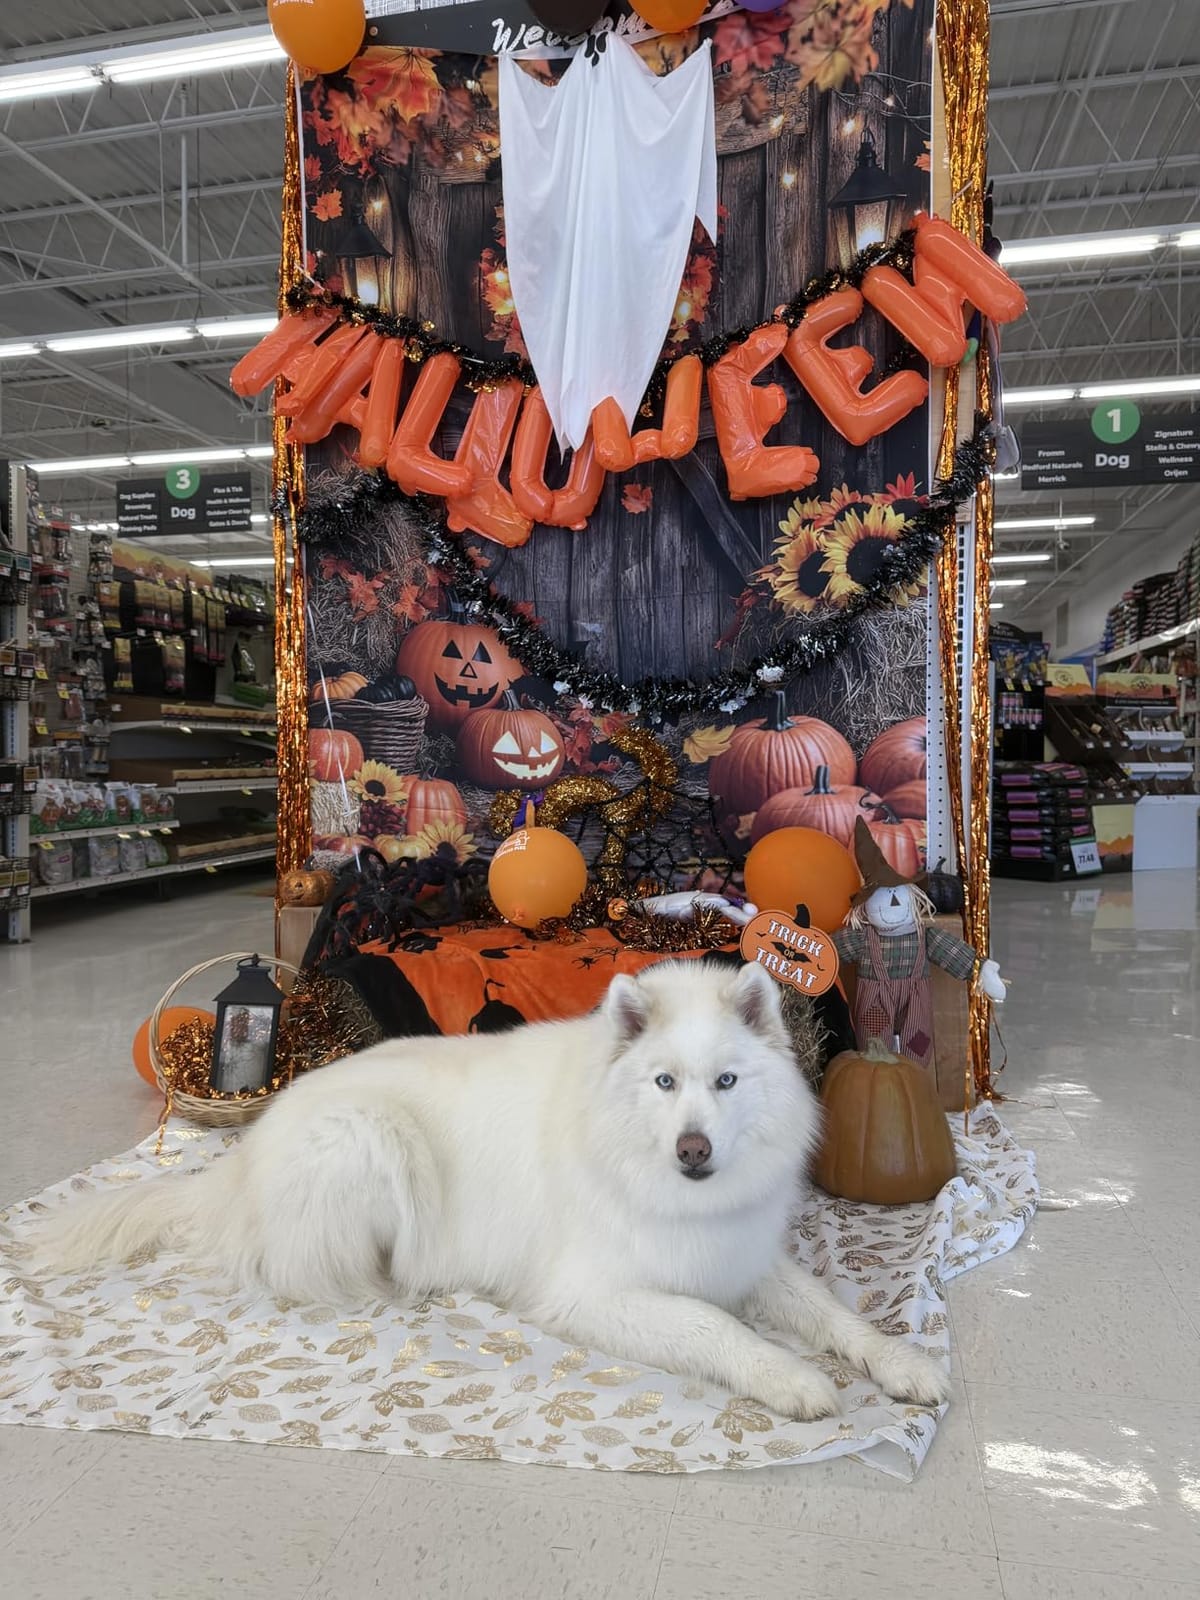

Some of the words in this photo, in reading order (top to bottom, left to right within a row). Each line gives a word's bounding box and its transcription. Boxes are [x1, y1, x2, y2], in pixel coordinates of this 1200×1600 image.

[1107, 408, 1121, 432] 1
[1154, 430, 1194, 438] Zignature
[1095, 454, 1130, 468] Dog
[1158, 456, 1194, 464] Wellness
[1052, 462, 1083, 470] Naturals
[1038, 474, 1067, 483] Merrick
[1164, 469, 1188, 478] Orijen
[176, 469, 191, 490] 3
[132, 492, 156, 500] Supplies
[170, 506, 196, 520] Dog
[768, 919, 824, 958] TRICK
[784, 949, 795, 959] OR
[756, 946, 818, 988] TREAT
